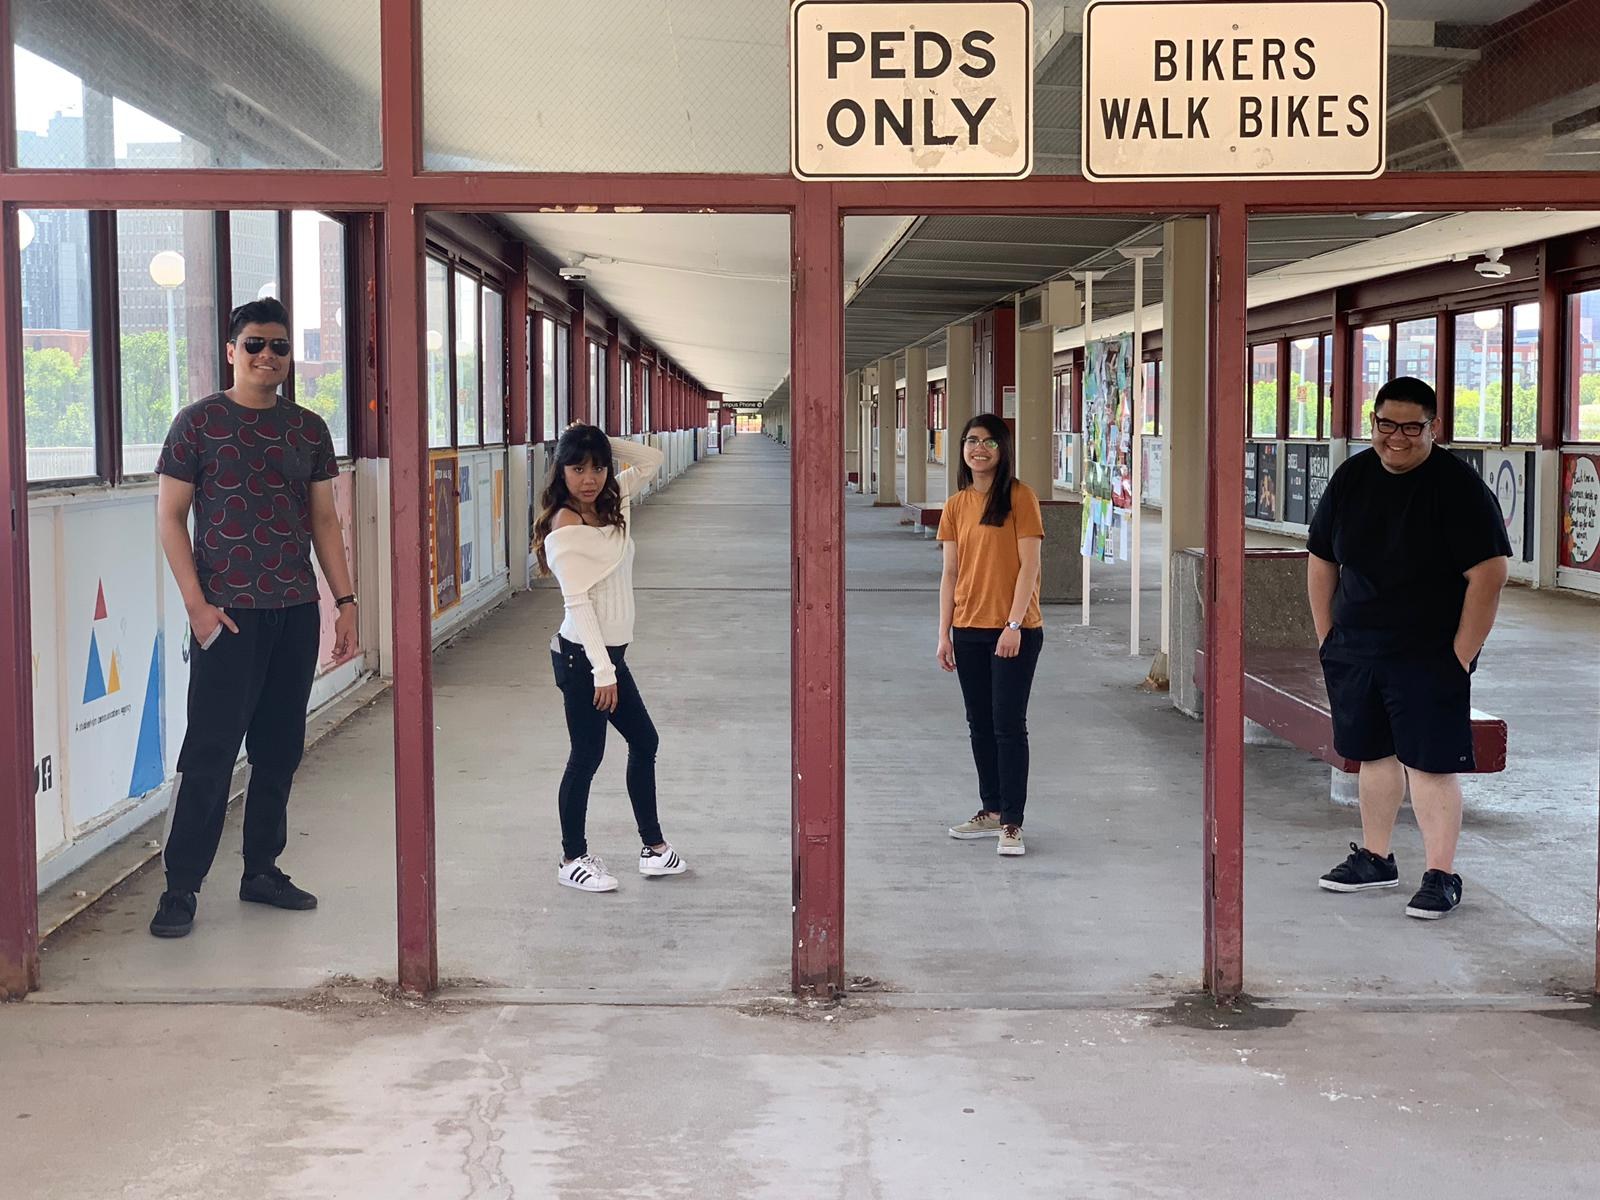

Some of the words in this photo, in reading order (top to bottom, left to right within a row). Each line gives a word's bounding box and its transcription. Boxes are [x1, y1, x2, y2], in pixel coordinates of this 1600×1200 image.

[827, 30, 997, 79] PEDS
[1154, 37, 1316, 81] BIKERS
[826, 98, 997, 147] ONLY
[1100, 97, 1210, 140] WALK
[1239, 95, 1370, 139] BIKES
